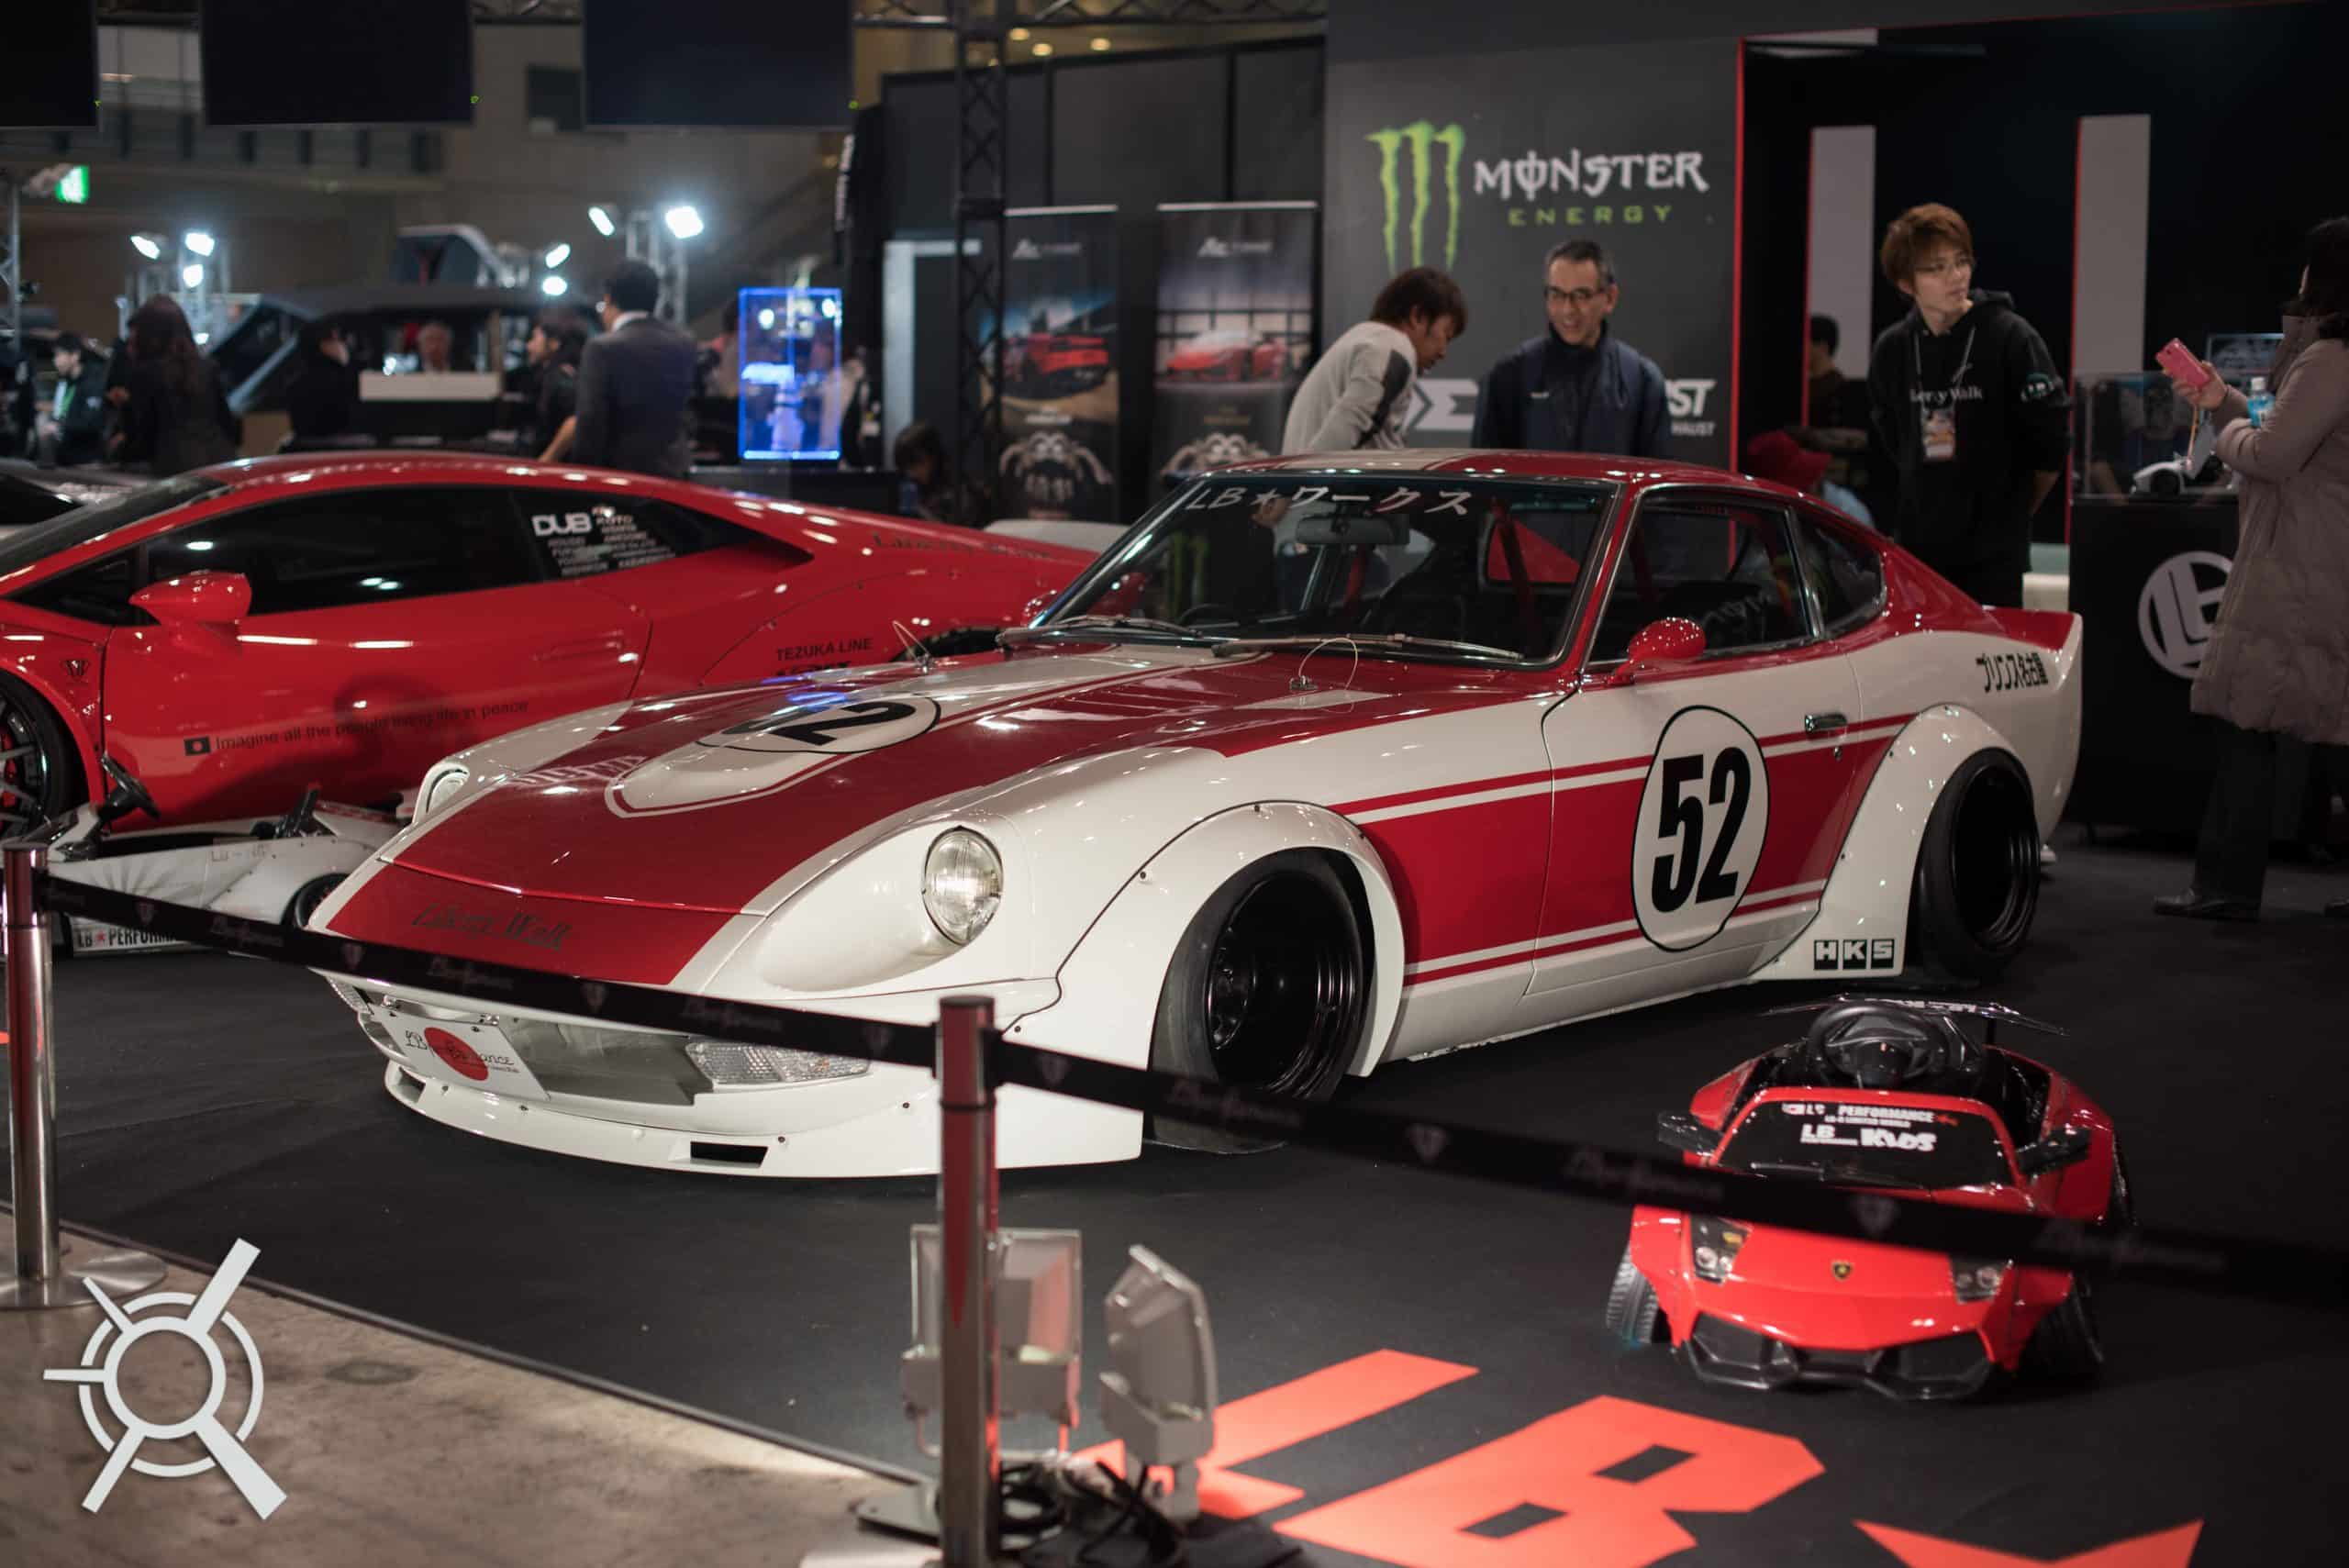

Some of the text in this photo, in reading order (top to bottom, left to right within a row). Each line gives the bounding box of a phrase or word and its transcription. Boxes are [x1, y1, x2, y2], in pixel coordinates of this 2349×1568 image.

[1474, 149, 1709, 201] MONSTER
[1508, 206, 1673, 227] ENERGY
[531, 512, 593, 537] DUB
[775, 638, 873, 662] TEZUKA LINE
[216, 732, 278, 750] Imagine
[283, 726, 301, 742] all
[306, 724, 331, 739] the
[1652, 747, 1751, 912] 52
[1813, 939, 1895, 971] HKS
